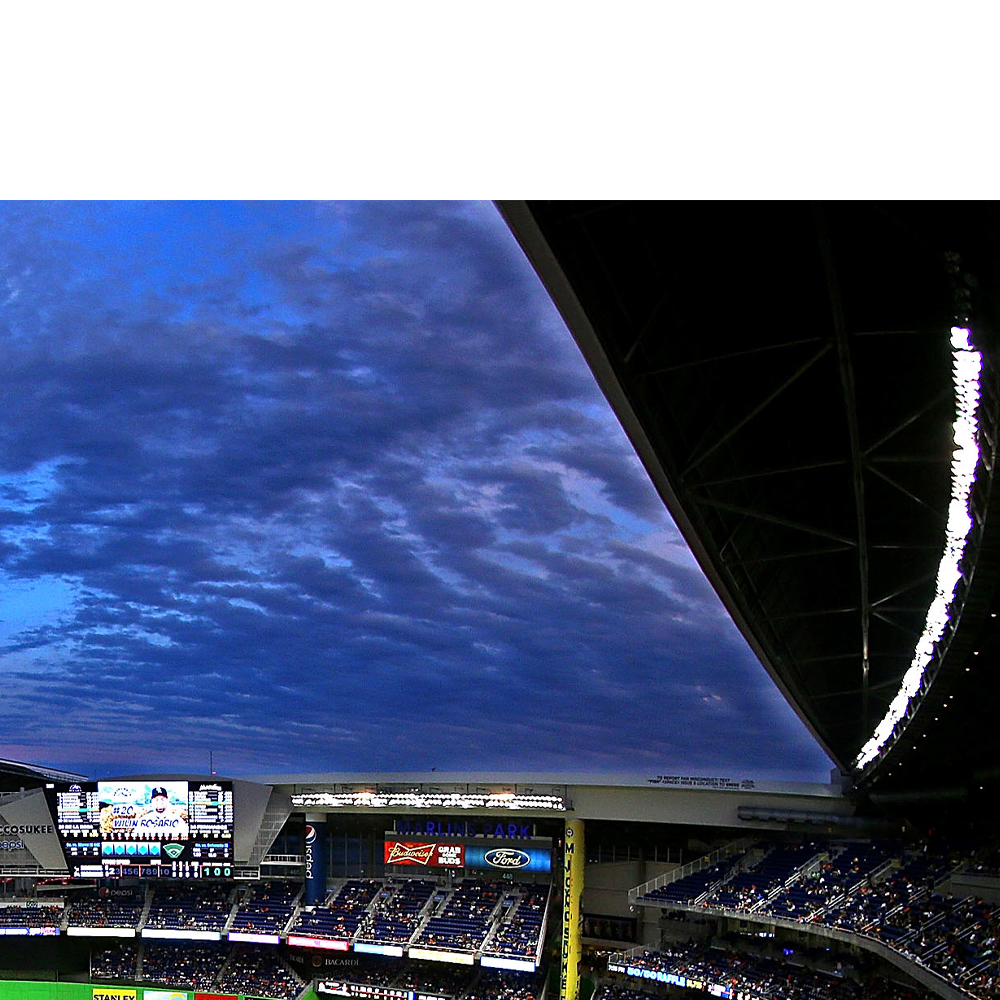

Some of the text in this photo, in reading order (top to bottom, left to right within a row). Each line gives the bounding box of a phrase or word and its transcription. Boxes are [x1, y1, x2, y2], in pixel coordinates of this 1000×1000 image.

[397, 821, 531, 839] MARLINS PARK
[388, 847, 433, 858] Budweiser
[493, 852, 522, 866] Ford
[304, 845, 313, 879] pepsi
[438, 857, 462, 865] BUDS
[325, 958, 359, 966] BACARDI
[657, 972, 686, 987] RAFFLE
